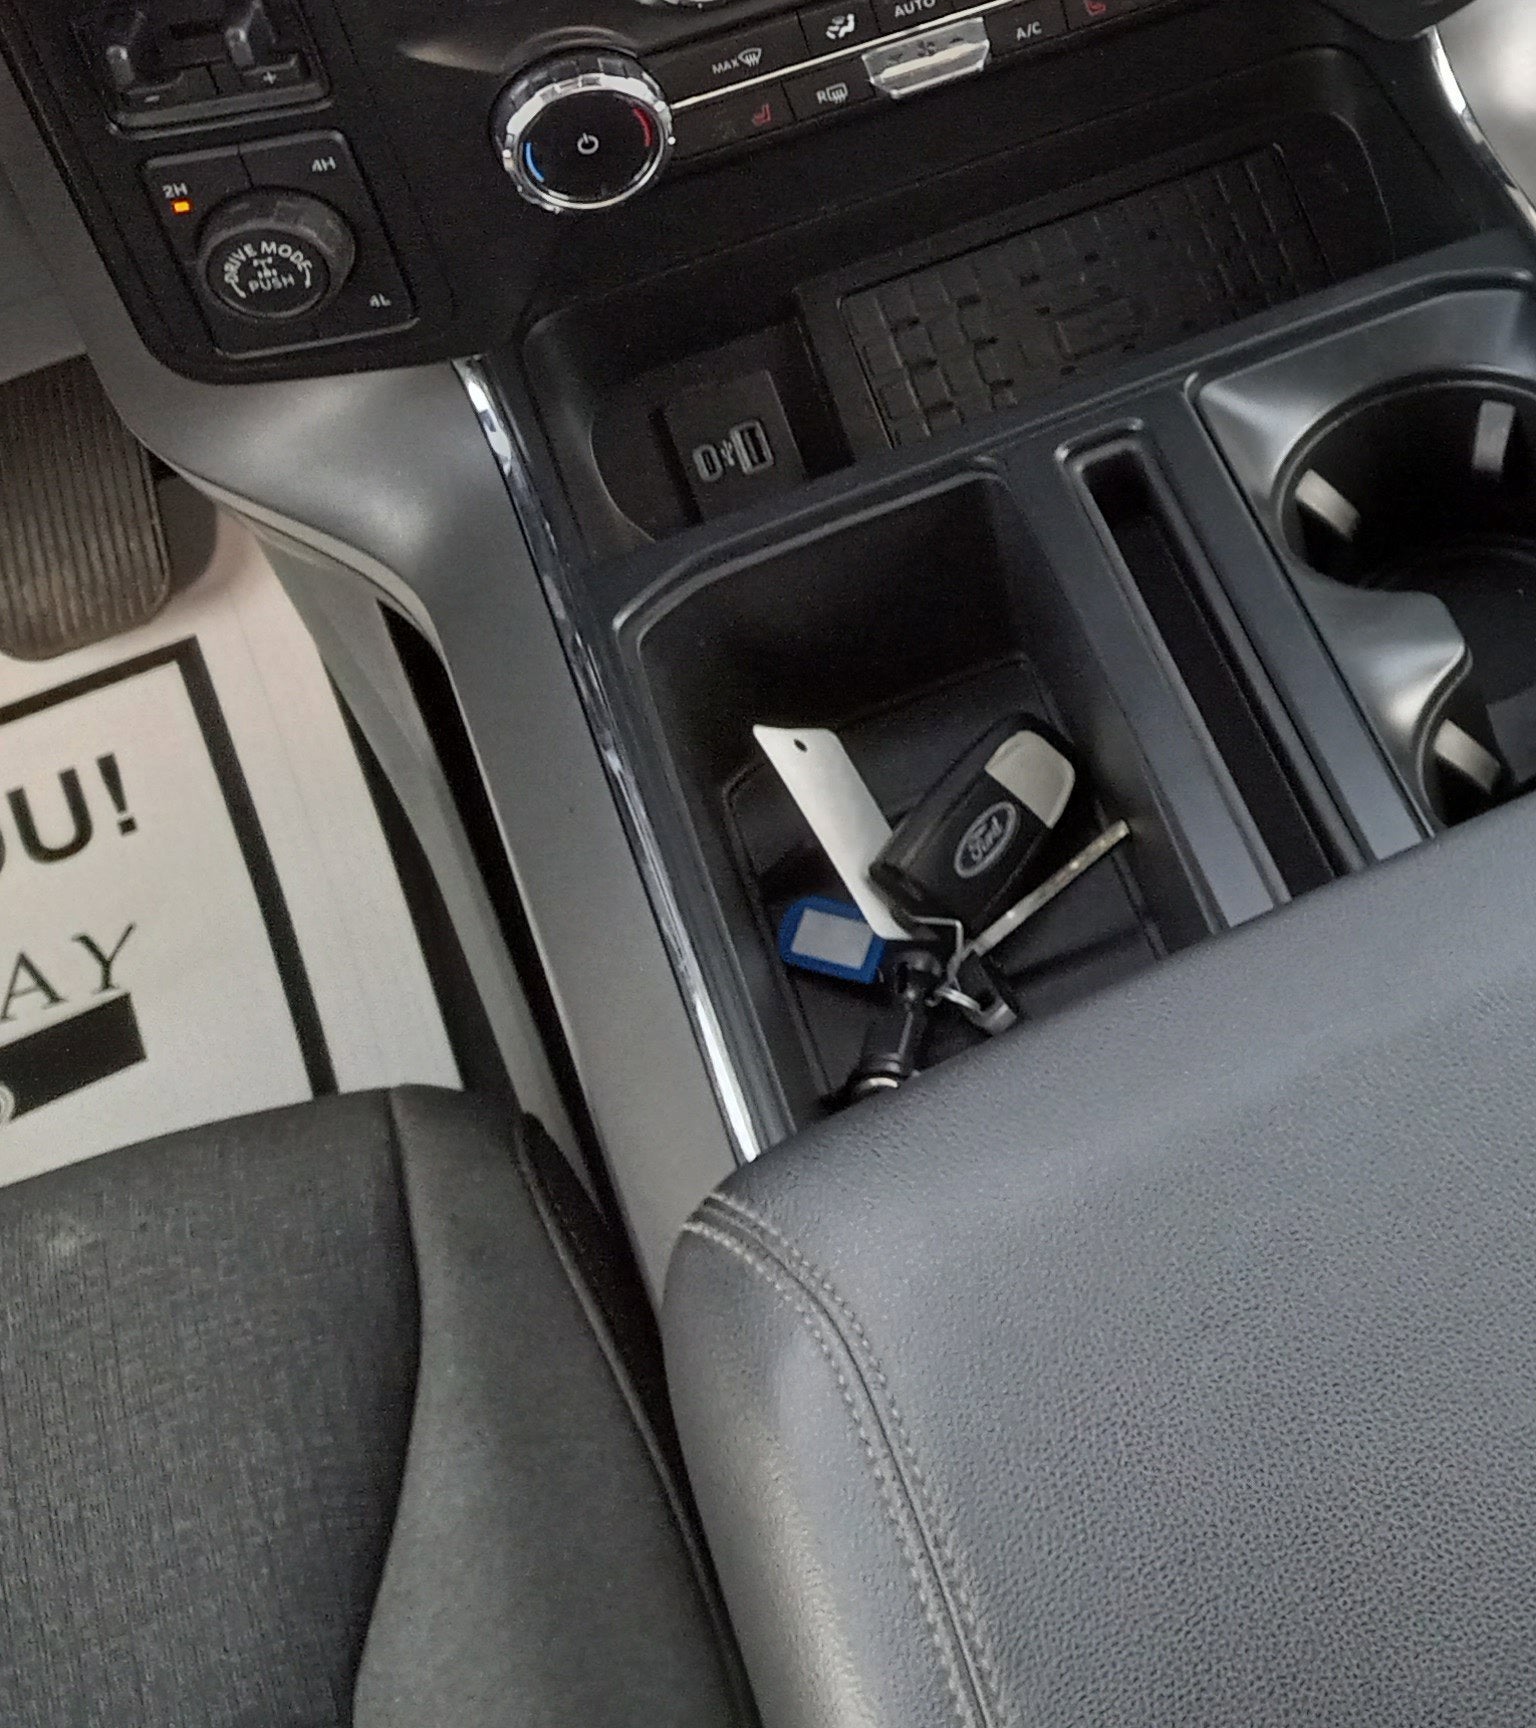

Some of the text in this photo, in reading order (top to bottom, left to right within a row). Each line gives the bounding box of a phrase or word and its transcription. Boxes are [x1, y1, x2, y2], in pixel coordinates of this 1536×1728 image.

[1016, 20, 1043, 41] A/C
[712, 57, 740, 75] MAX
[312, 156, 337, 173] 4H
[163, 181, 188, 199] 2H
[224, 239, 312, 284] DRIVE MODE
[248, 273, 295, 293] PUSH
[370, 292, 391, 308] 4L
[0, 752, 138, 872] U!
